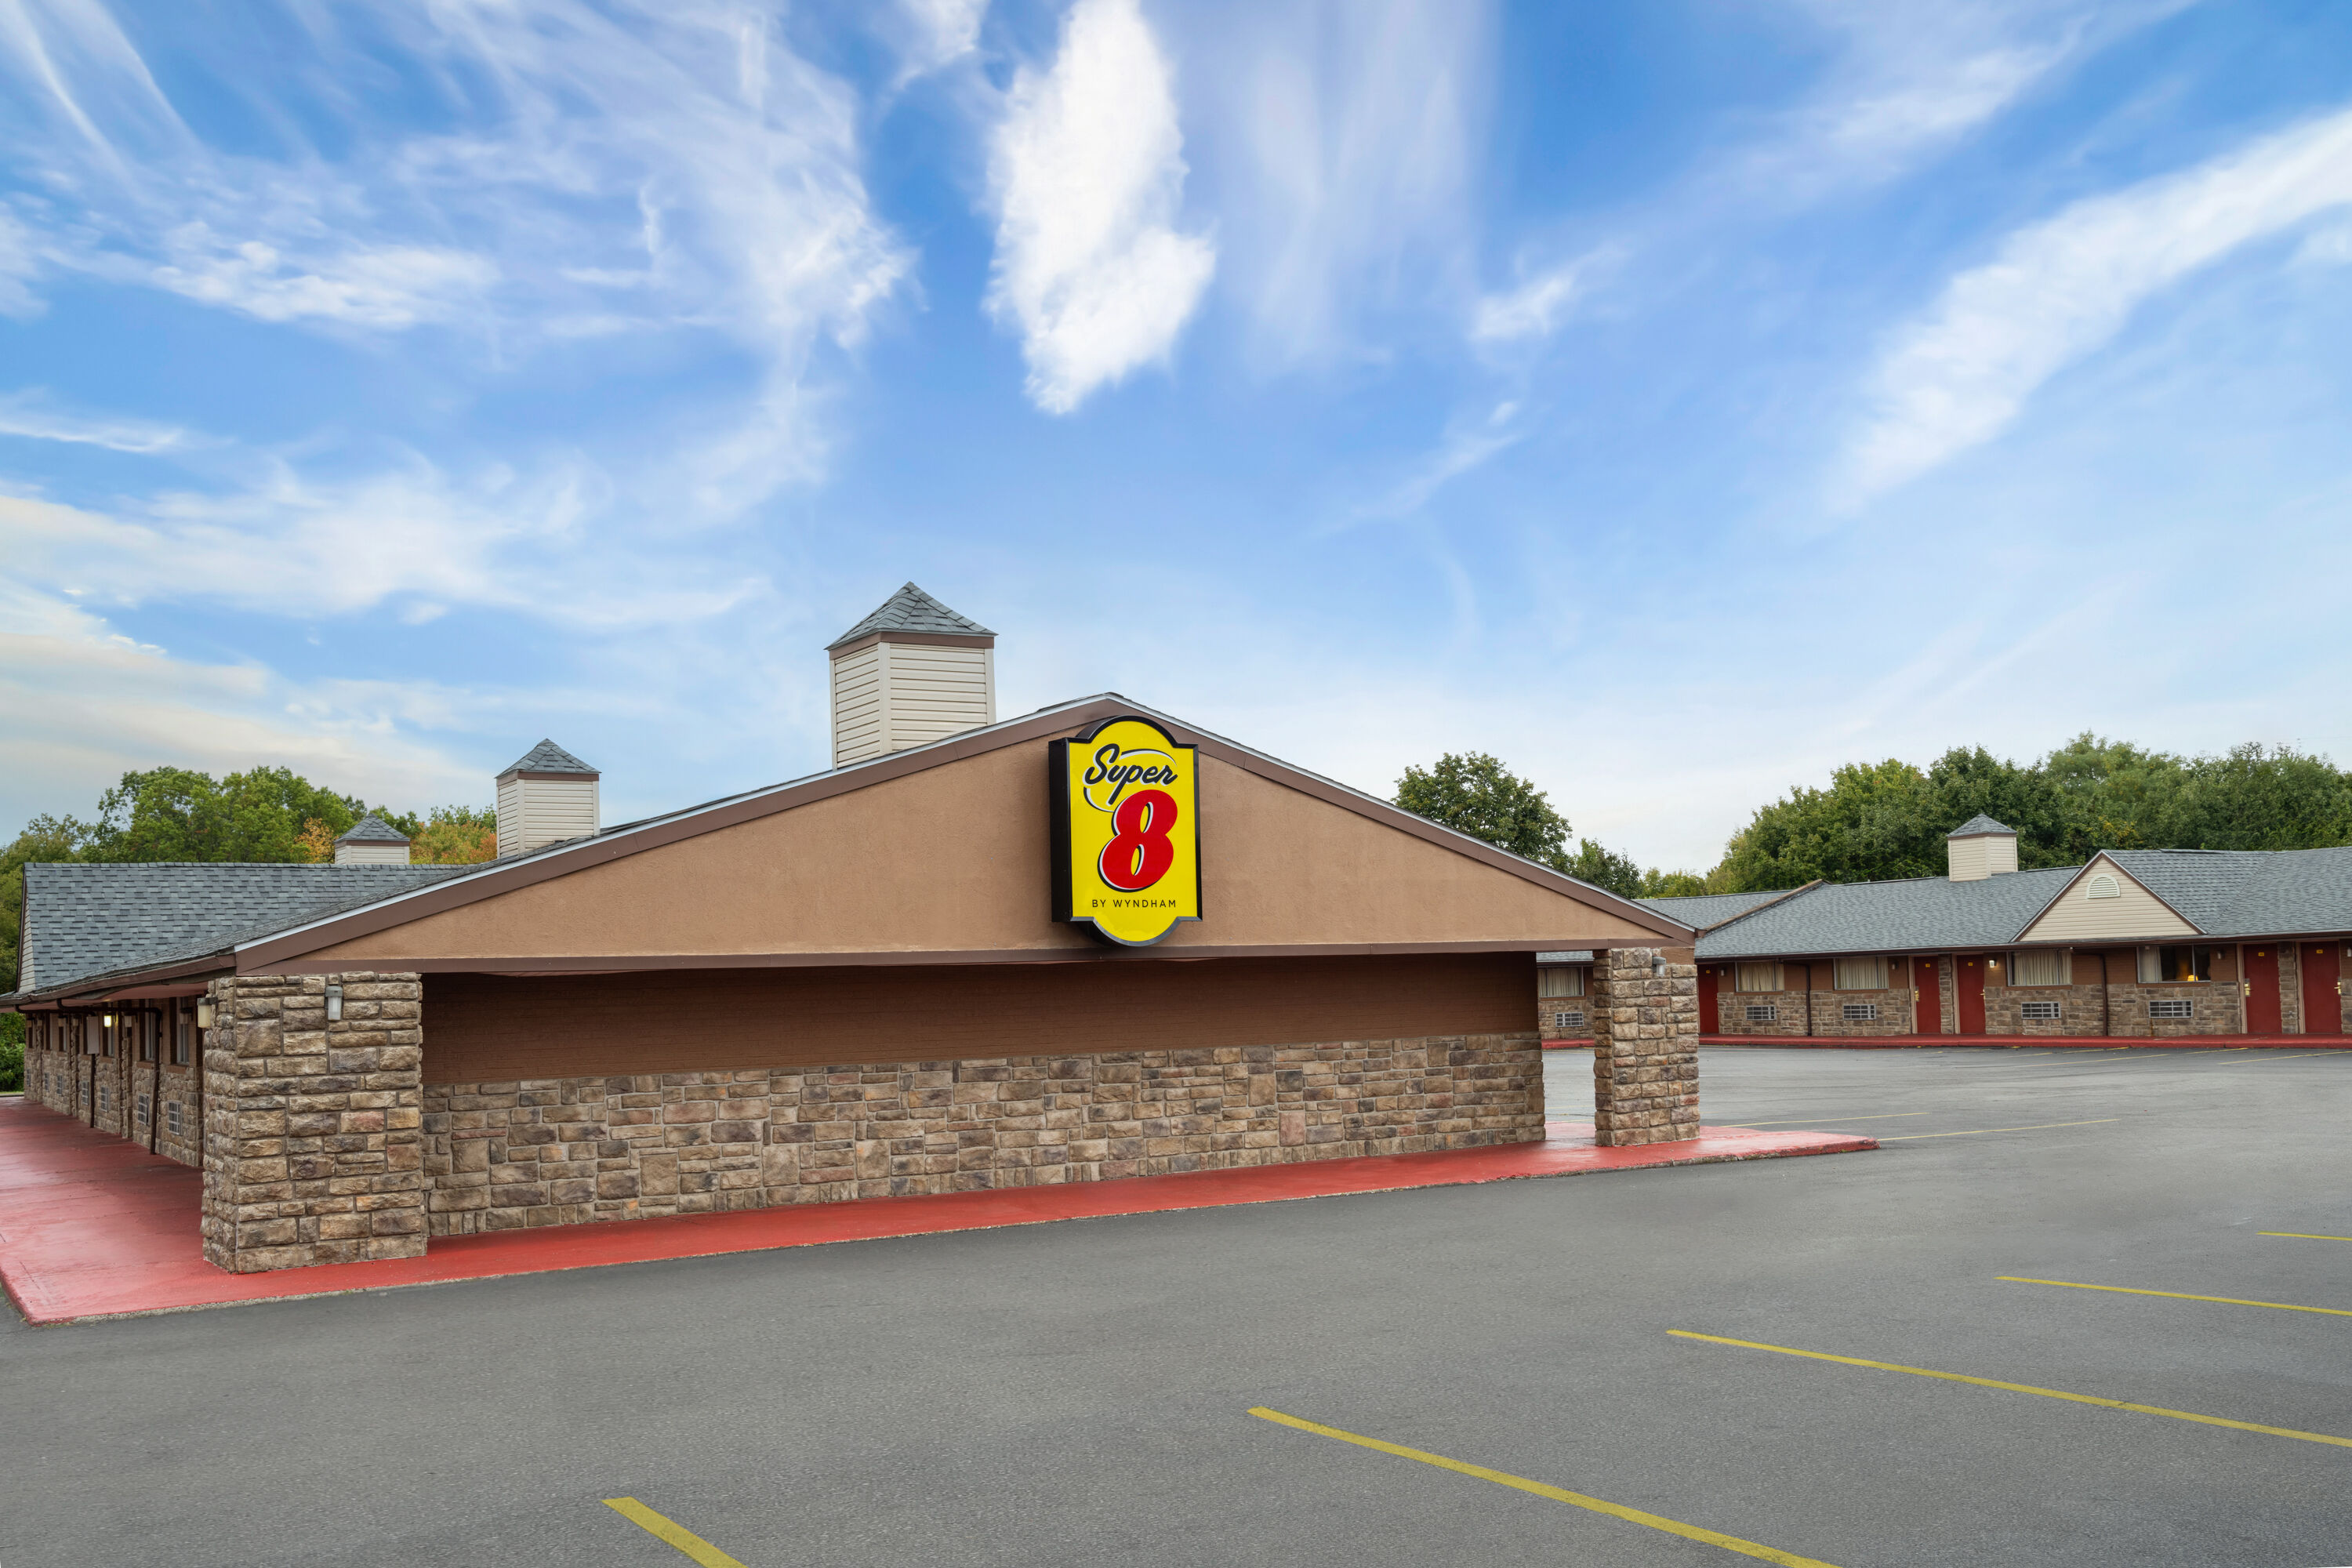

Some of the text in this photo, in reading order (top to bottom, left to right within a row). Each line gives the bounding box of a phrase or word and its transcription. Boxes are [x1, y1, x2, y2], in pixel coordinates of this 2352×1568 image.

[1083, 743, 1178, 805] Super
[1098, 789, 1178, 892] 8
[1092, 899, 1176, 908] BY WYNDHAM
